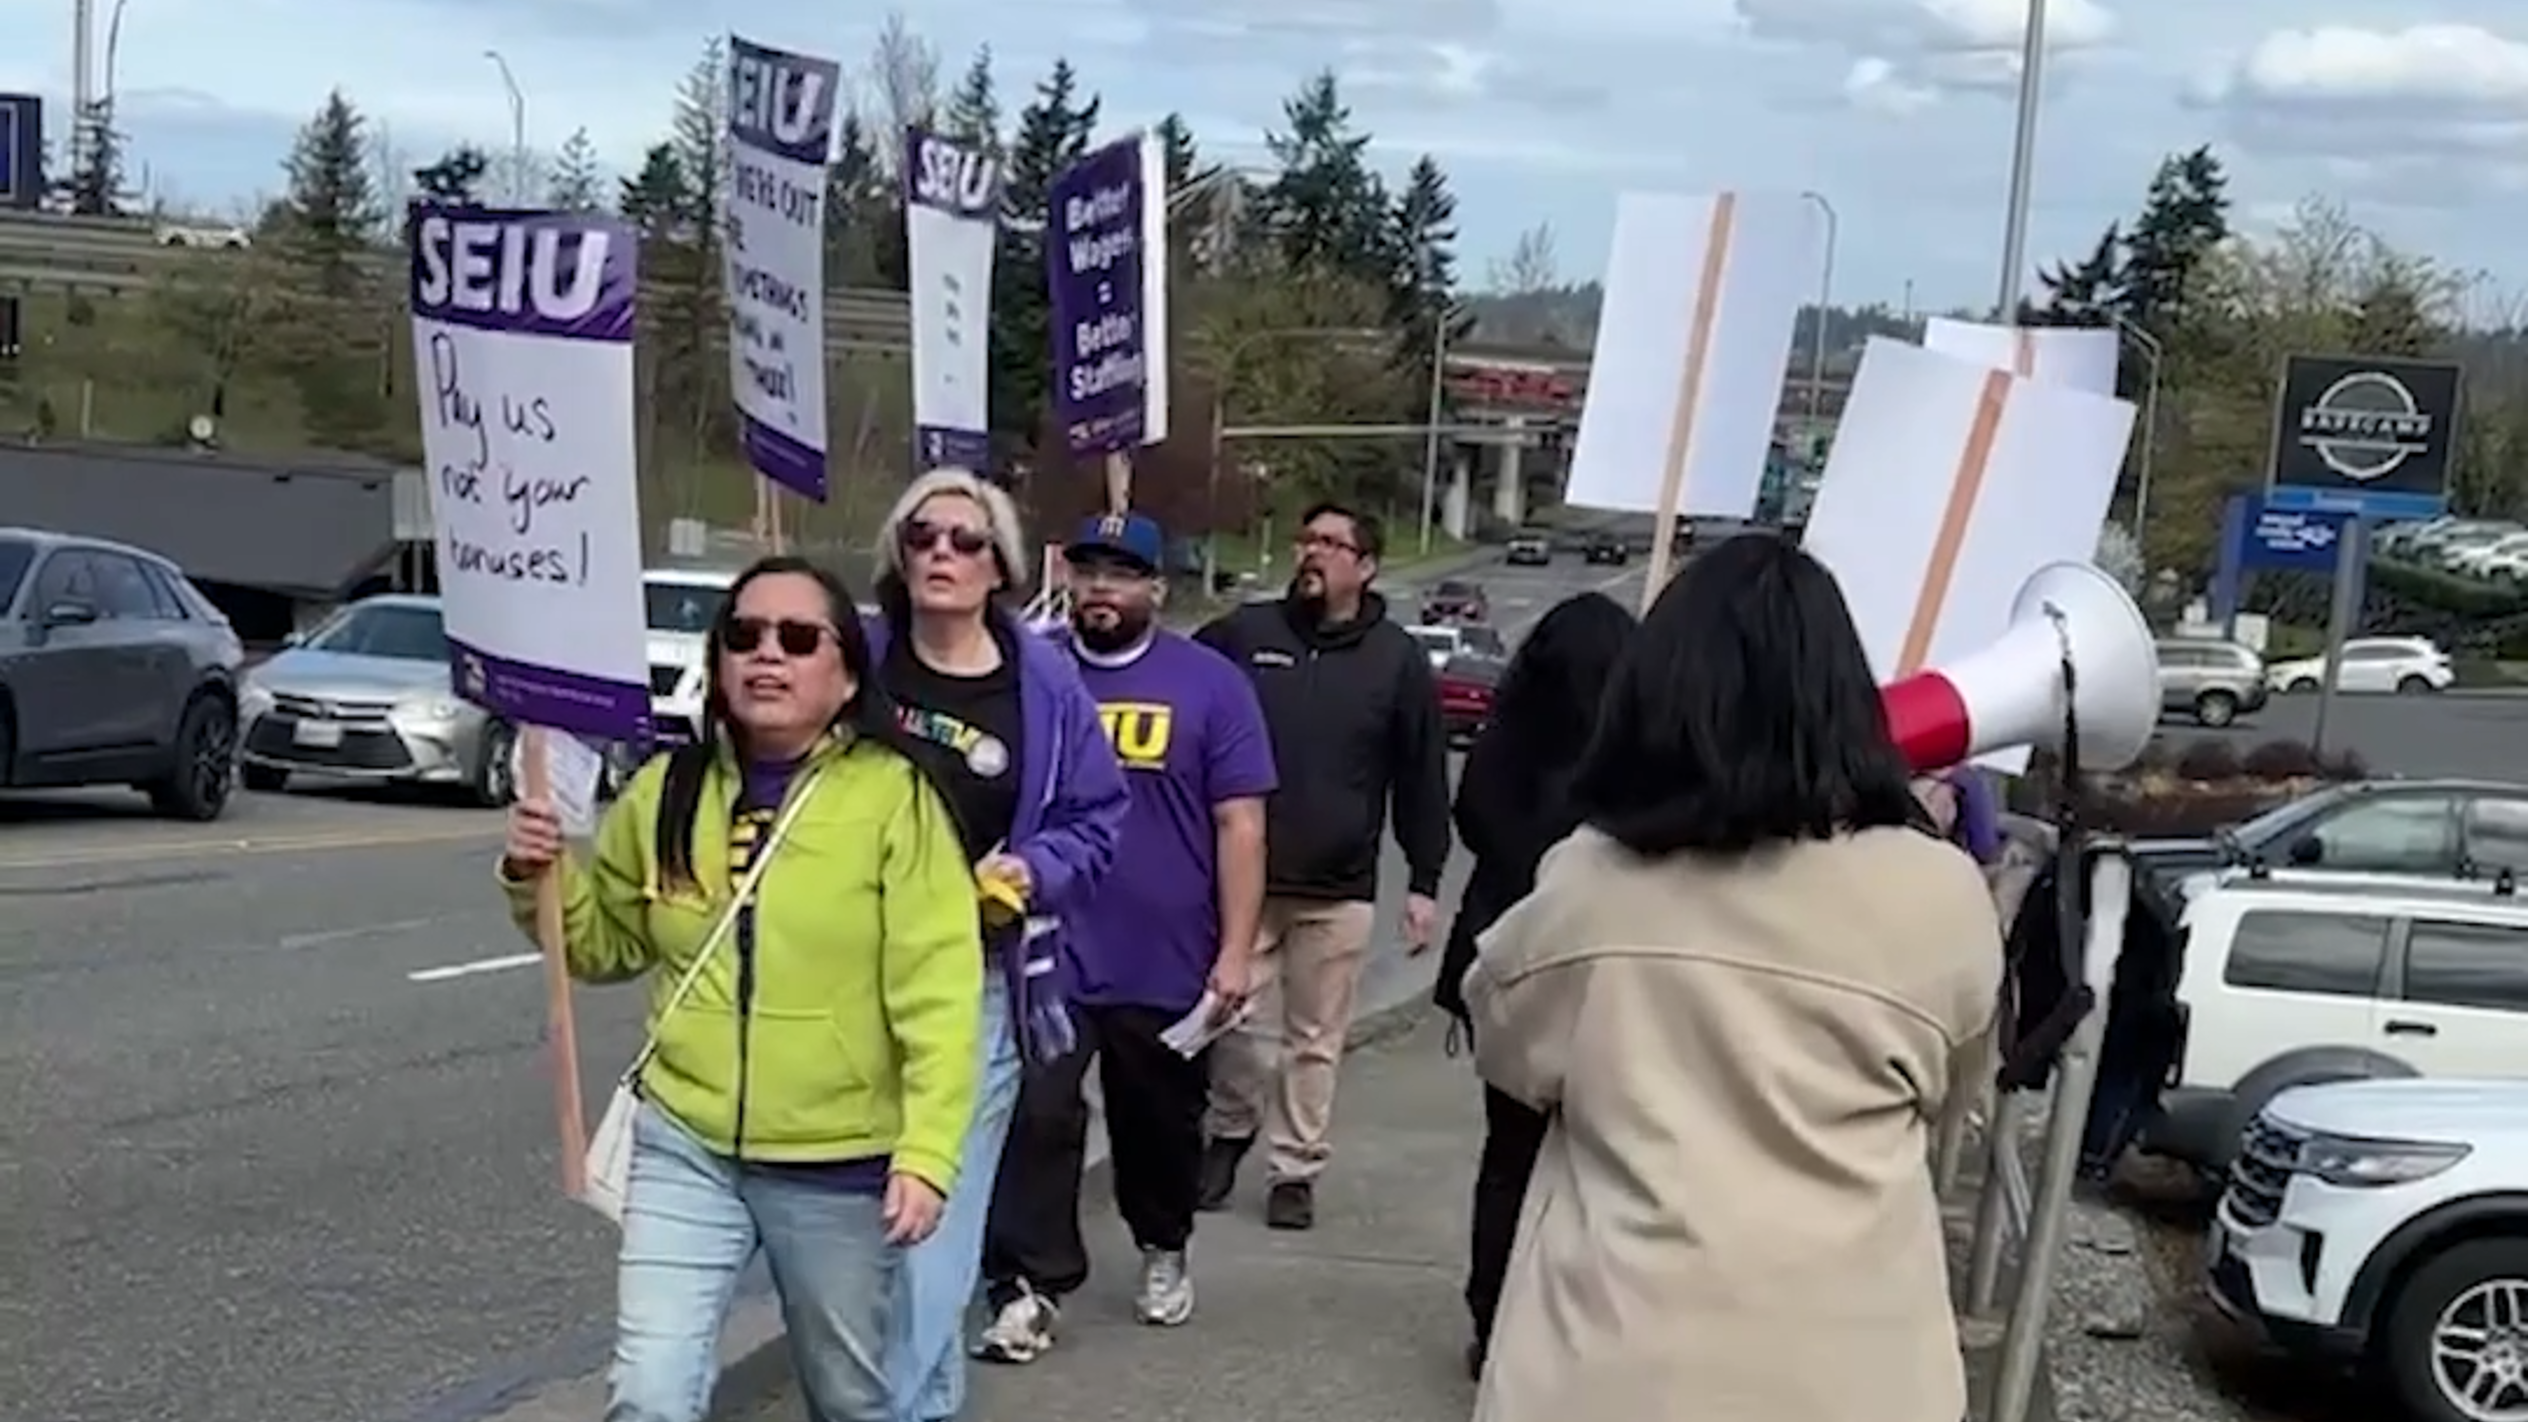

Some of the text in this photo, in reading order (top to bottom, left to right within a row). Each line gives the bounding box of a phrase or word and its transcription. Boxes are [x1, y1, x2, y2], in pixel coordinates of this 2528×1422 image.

[733, 53, 823, 143] EIU
[1066, 181, 1129, 232] Better
[420, 217, 609, 320] SEIU
[432, 333, 556, 470] Pay us
[503, 470, 591, 536] your
